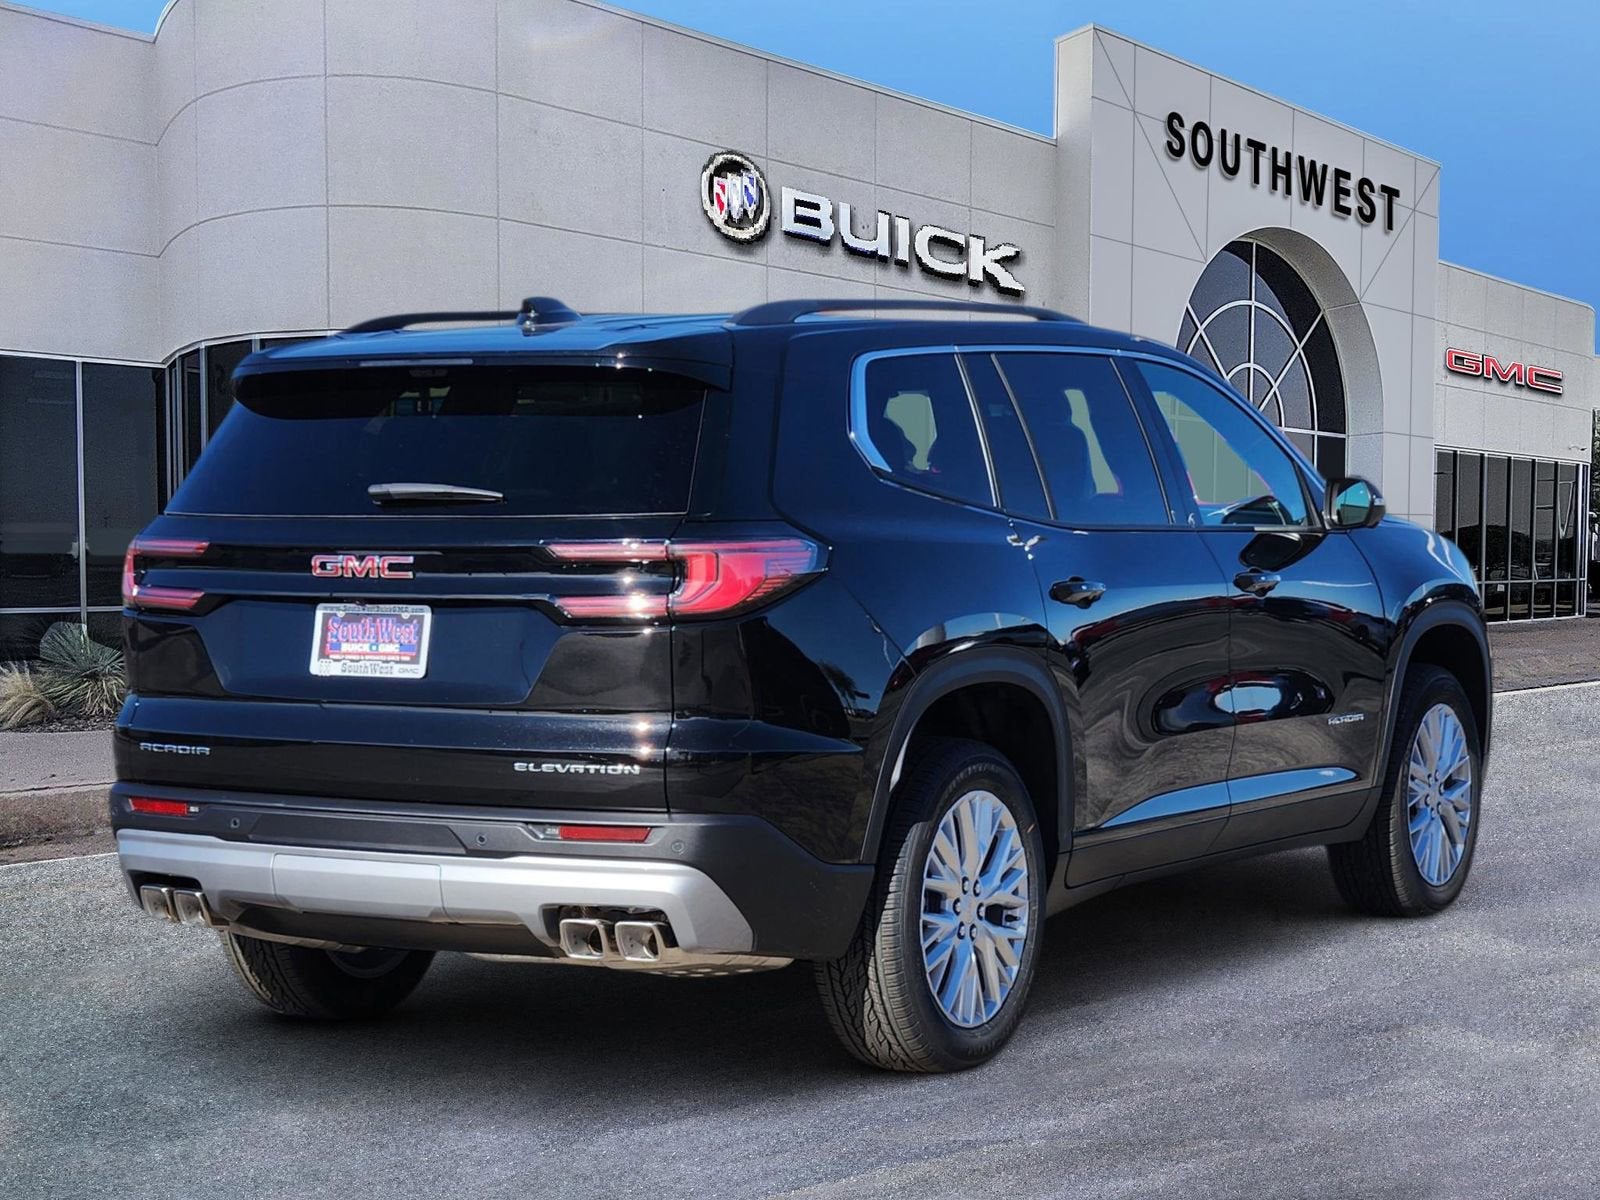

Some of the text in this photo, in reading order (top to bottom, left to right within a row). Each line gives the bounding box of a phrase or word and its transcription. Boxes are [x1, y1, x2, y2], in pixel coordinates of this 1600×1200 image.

[1166, 112, 1400, 231] SOUTHWEST
[782, 186, 1025, 296] BUICK
[1446, 347, 1563, 394] GMC
[311, 555, 414, 579] GMC
[140, 742, 211, 755] ACADIA
[513, 762, 640, 775] ELEVATION
